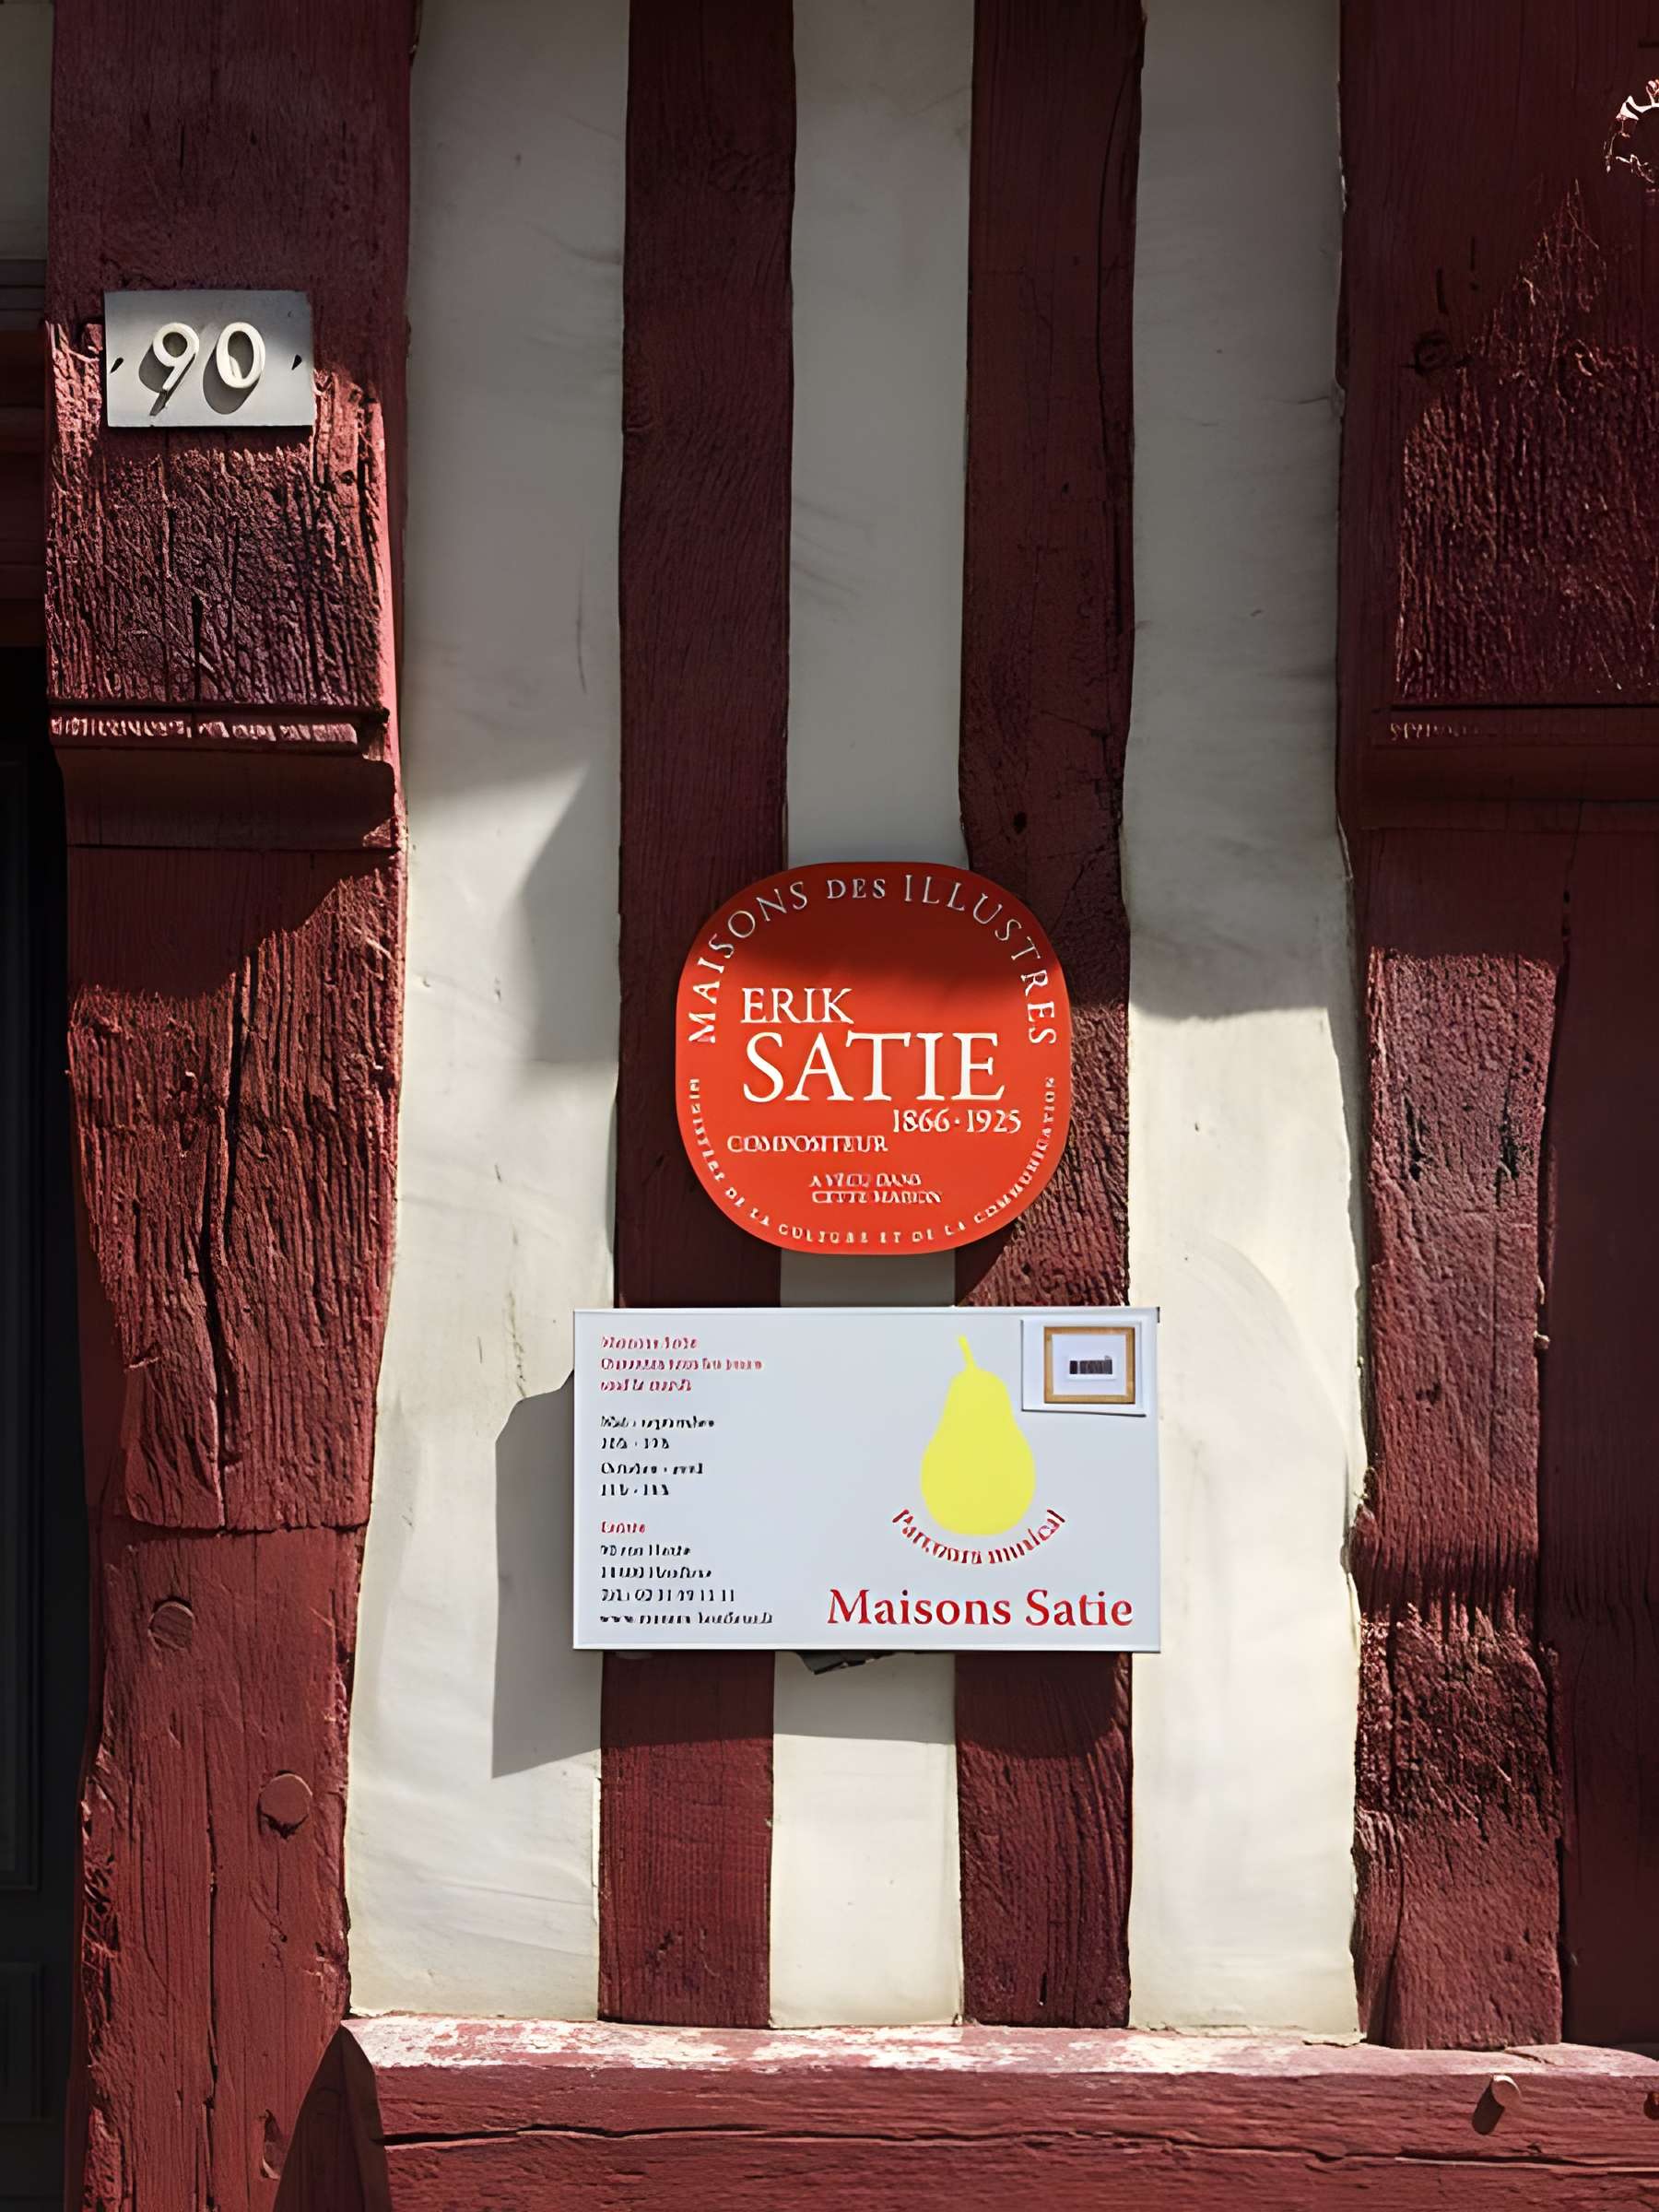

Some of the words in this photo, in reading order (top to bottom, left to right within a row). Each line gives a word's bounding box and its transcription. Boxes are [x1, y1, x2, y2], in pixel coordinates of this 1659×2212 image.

[151, 322, 266, 392] 90
[688, 881, 808, 1043] MAISONS
[827, 878, 886, 900] DES
[904, 875, 1058, 1045] ILLUSTRES
[740, 987, 854, 1024] ERIK
[743, 1030, 1006, 1103] SATIE
[828, 1589, 1011, 1626] Maisons
[1025, 1588, 1134, 1627] Satie
